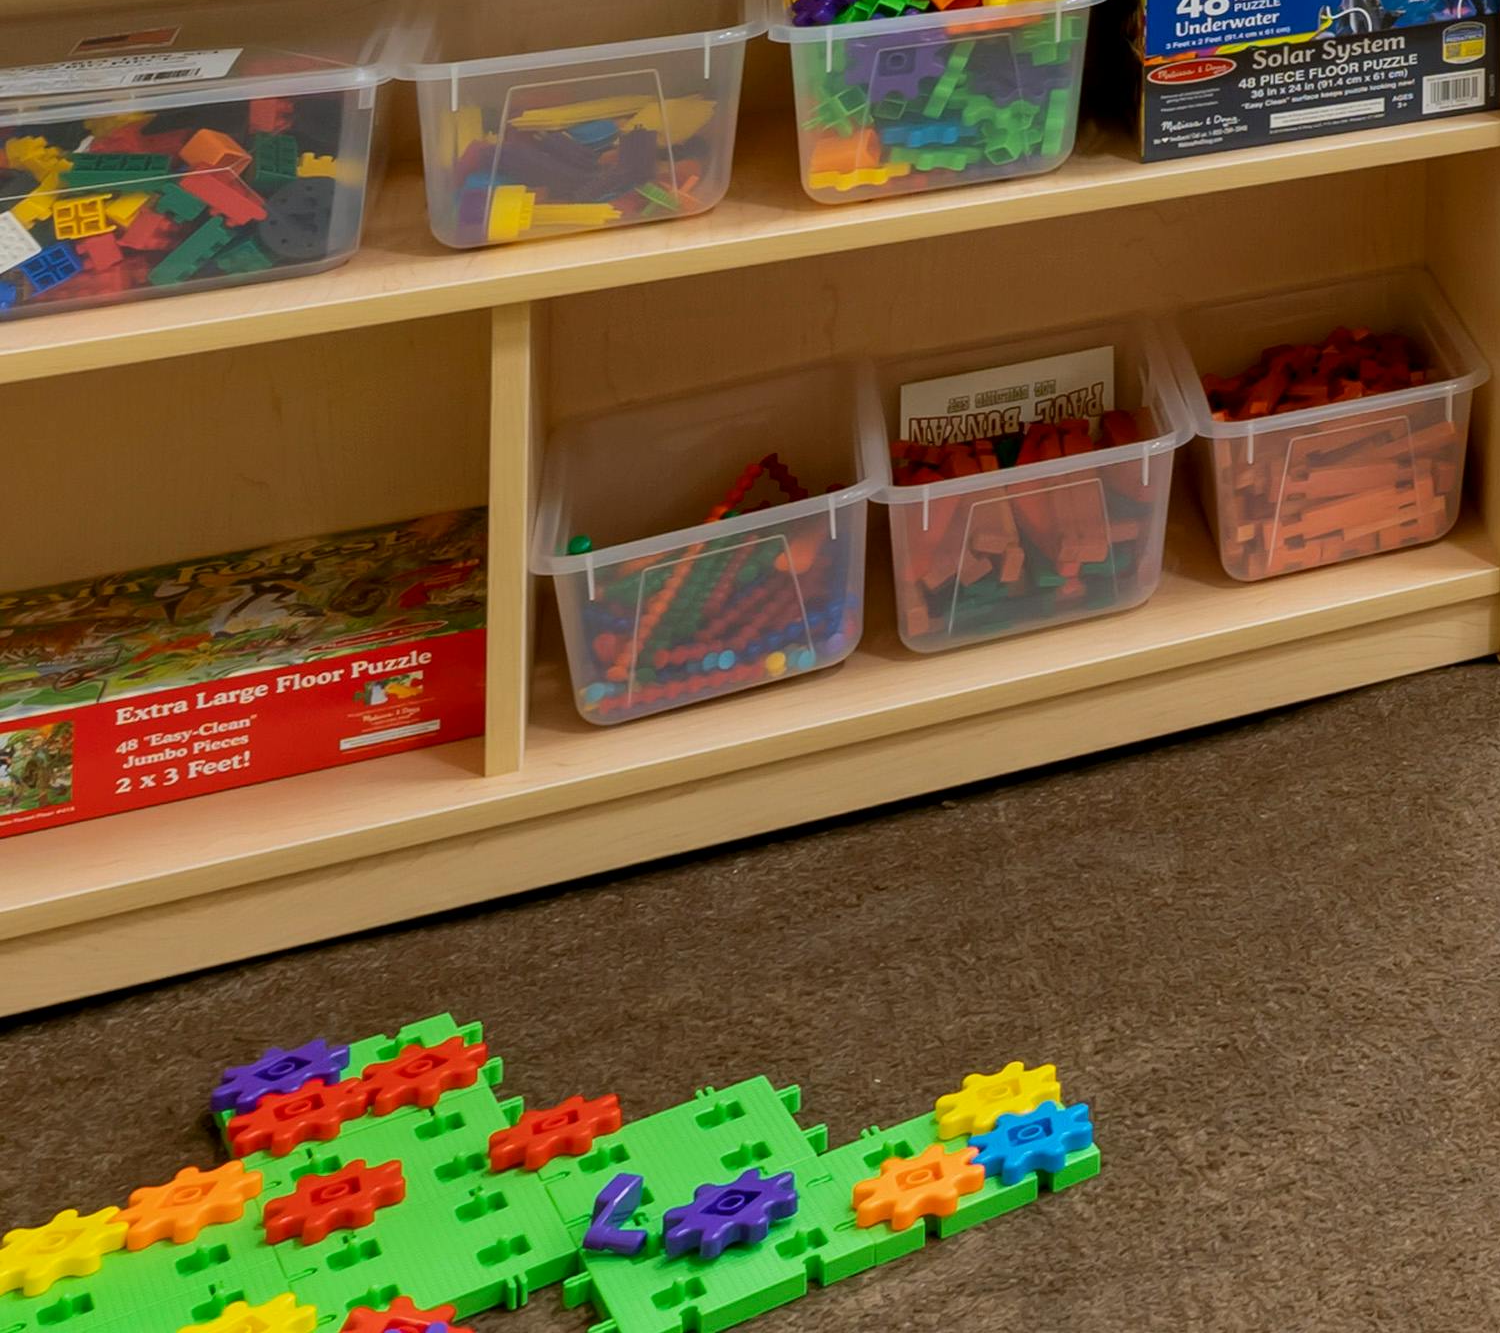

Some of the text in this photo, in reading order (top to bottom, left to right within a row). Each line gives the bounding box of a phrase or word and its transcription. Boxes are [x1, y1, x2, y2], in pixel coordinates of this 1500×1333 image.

[1176, 11, 1280, 37] Underwater
[1238, 53, 1418, 89] 48 PIECE FLOOR PUZZLE
[1252, 36, 1406, 70] Solar System
[1251, 89, 1264, 99] 36
[1267, 86, 1277, 96] in
[1287, 84, 1301, 93] 24
[1304, 81, 1315, 91] in
[1317, 77, 1344, 91] (91.4
[1346, 76, 1362, 85] cm
[1373, 71, 1385, 81] 61
[1389, 68, 1408, 80] cm)
[1392, 93, 1414, 102] AGES
[1035, 381, 1105, 424] PAUL
[908, 406, 1022, 447] BUNYAN
[115, 649, 433, 726] Extra Large Floor Puzzle
[115, 714, 257, 755] 48 "Easy-Clean"
[122, 734, 249, 770] Jumbo Pieces
[115, 750, 252, 794] 2 x 3 Feet!
